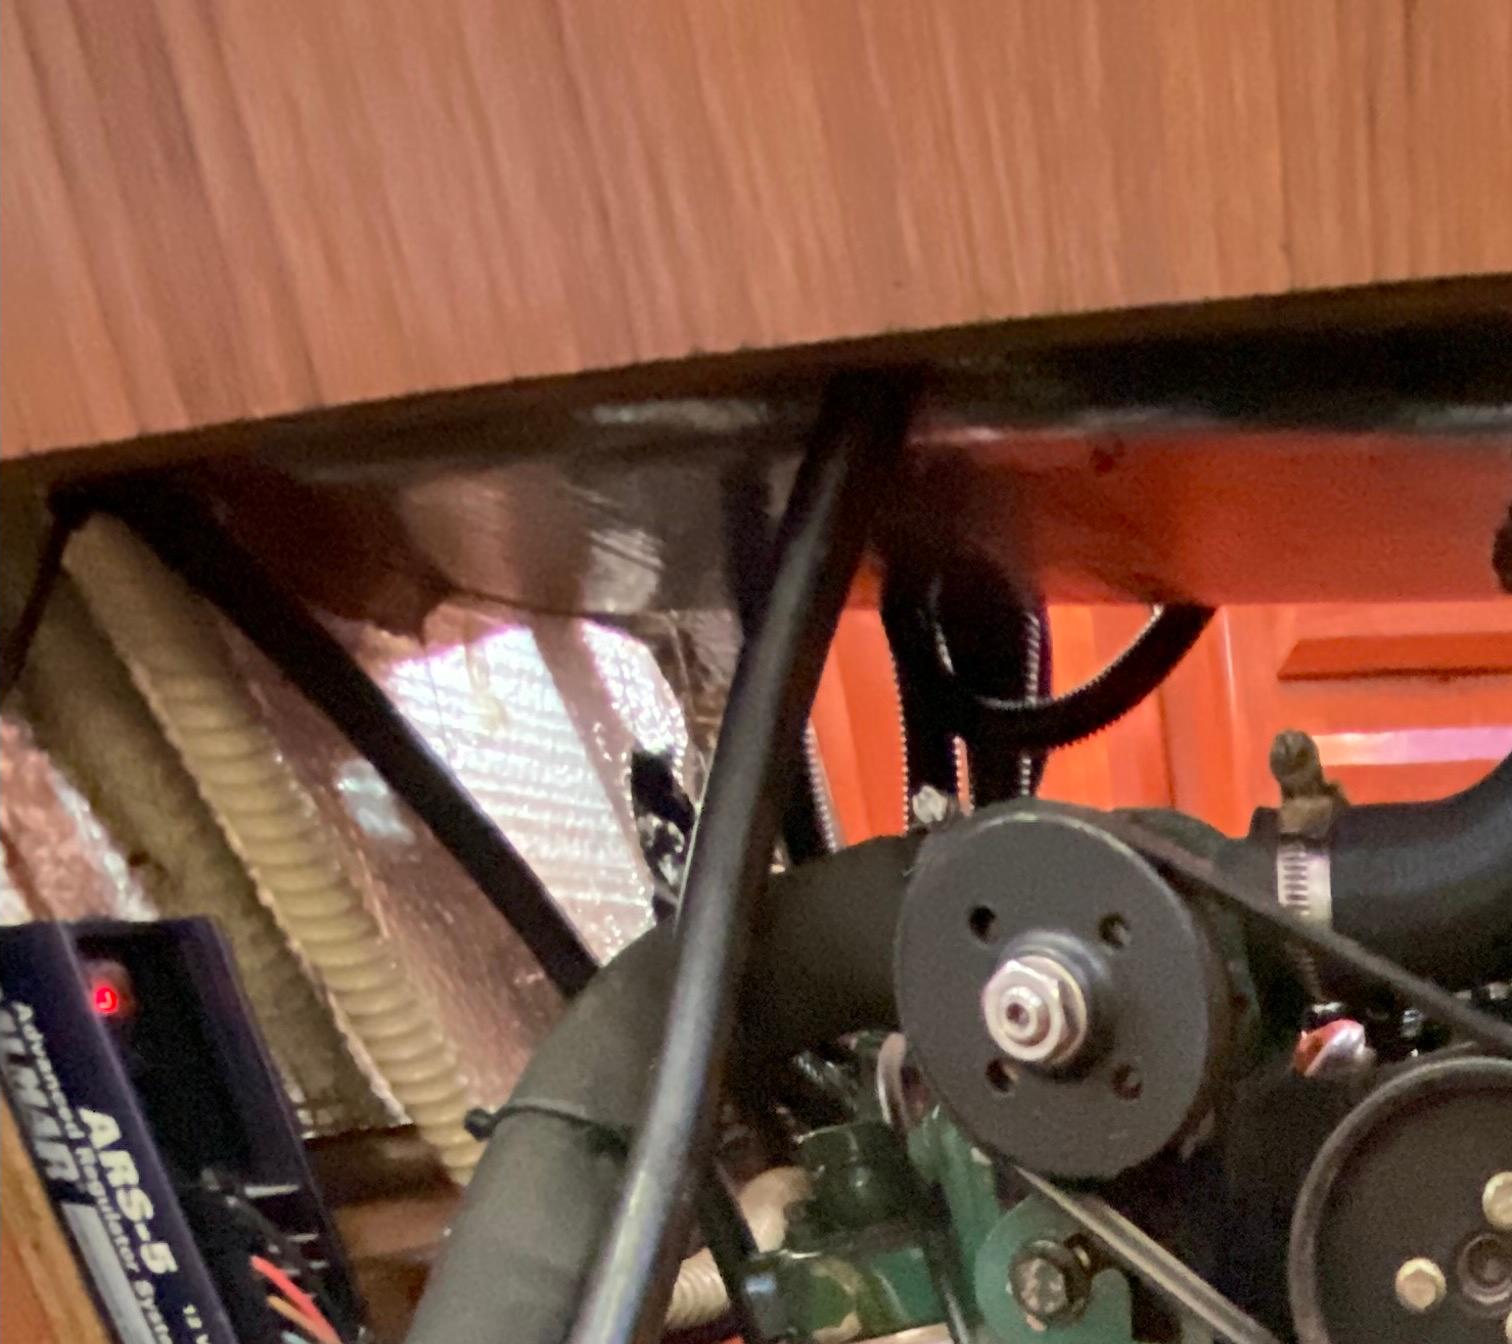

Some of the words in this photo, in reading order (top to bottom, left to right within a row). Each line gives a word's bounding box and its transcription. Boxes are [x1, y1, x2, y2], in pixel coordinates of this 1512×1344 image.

[12, 1001, 85, 1140] Advanced
[75, 1146, 141, 1274] Regulator
[78, 1105, 179, 1276] ARS-5
